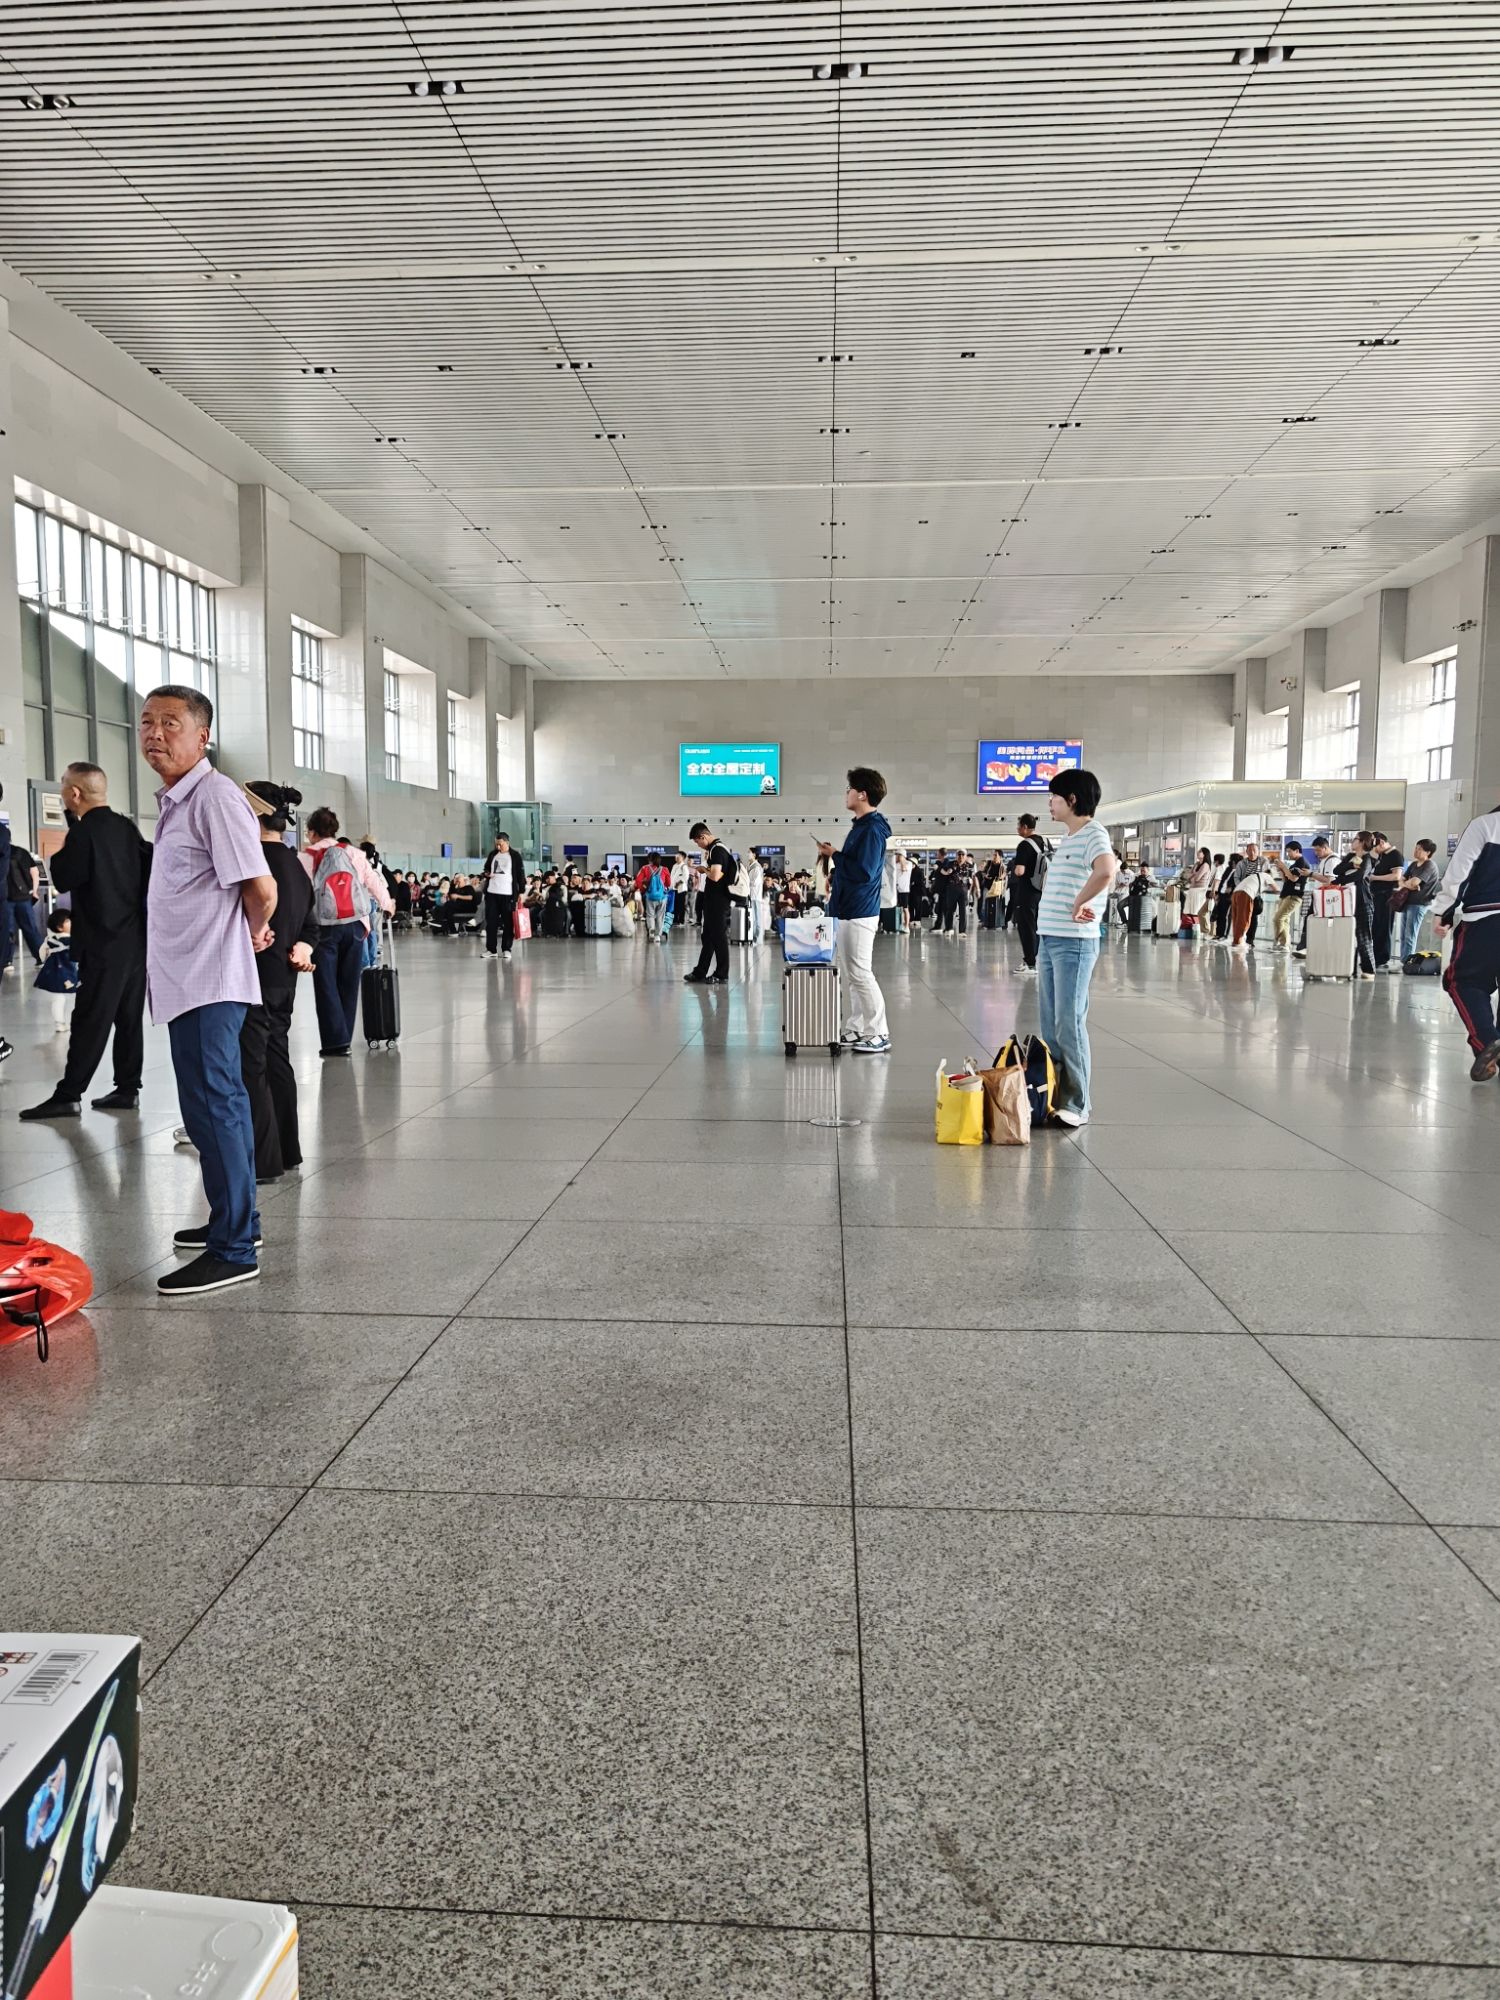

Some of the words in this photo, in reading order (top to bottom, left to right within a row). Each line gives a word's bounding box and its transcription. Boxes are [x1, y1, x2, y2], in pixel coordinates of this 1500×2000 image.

[686, 762, 766, 776] 全友全屋定制
